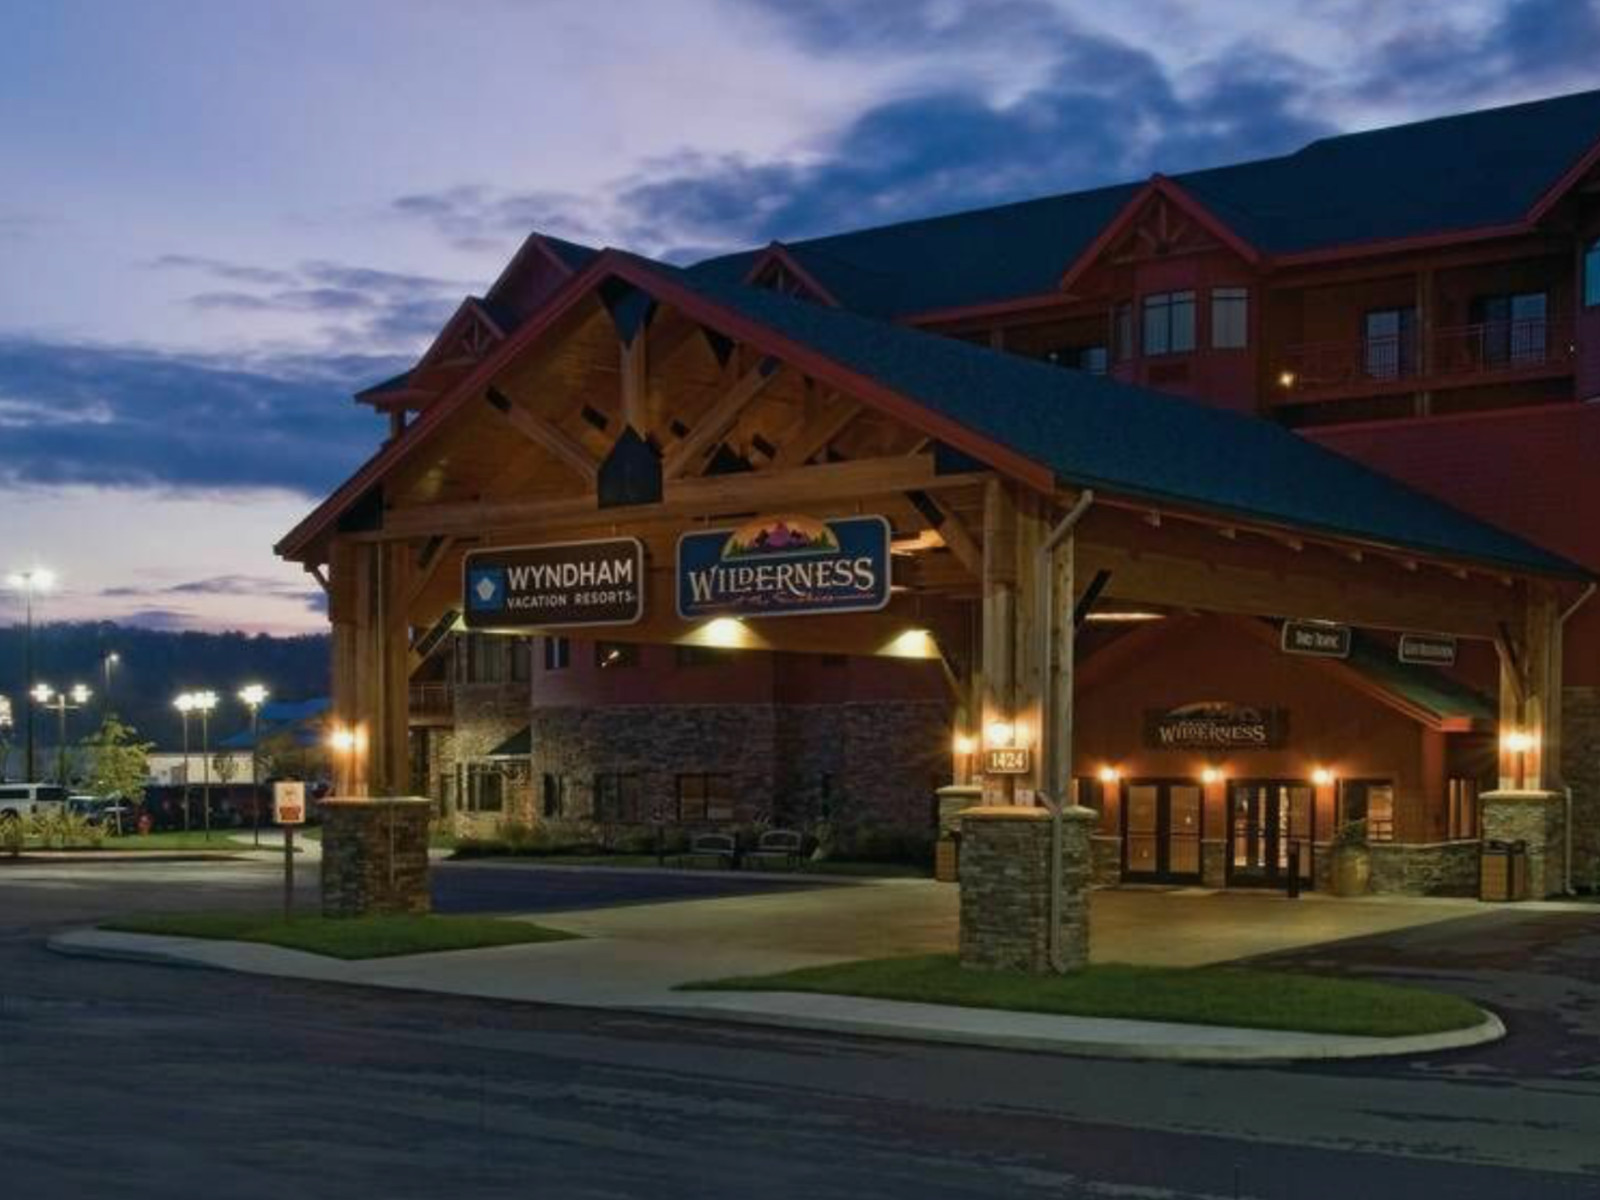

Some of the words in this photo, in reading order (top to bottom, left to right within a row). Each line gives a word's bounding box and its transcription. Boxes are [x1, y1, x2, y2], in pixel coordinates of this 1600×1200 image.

[507, 558, 633, 591] WYNDHAM
[688, 557, 875, 602] WILDERNESS
[507, 594, 568, 610] VACATION
[574, 590, 632, 606] RESORTS
[1159, 723, 1267, 744] WILDERNESS
